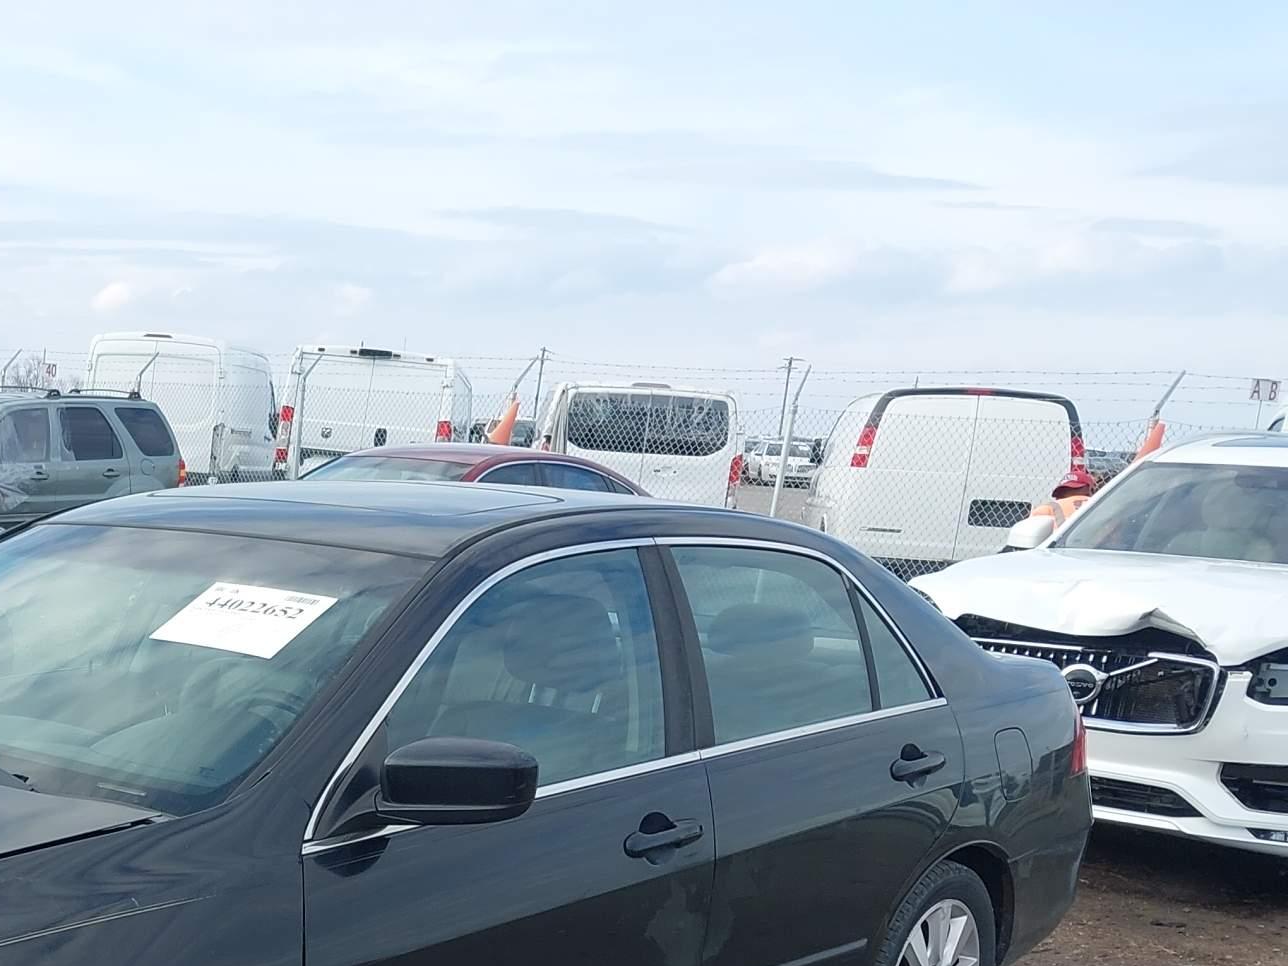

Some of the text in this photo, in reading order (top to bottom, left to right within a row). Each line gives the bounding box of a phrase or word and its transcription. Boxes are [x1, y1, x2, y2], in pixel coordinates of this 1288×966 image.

[1249, 379, 1278, 401] A B
[204, 596, 305, 619] 44022652
